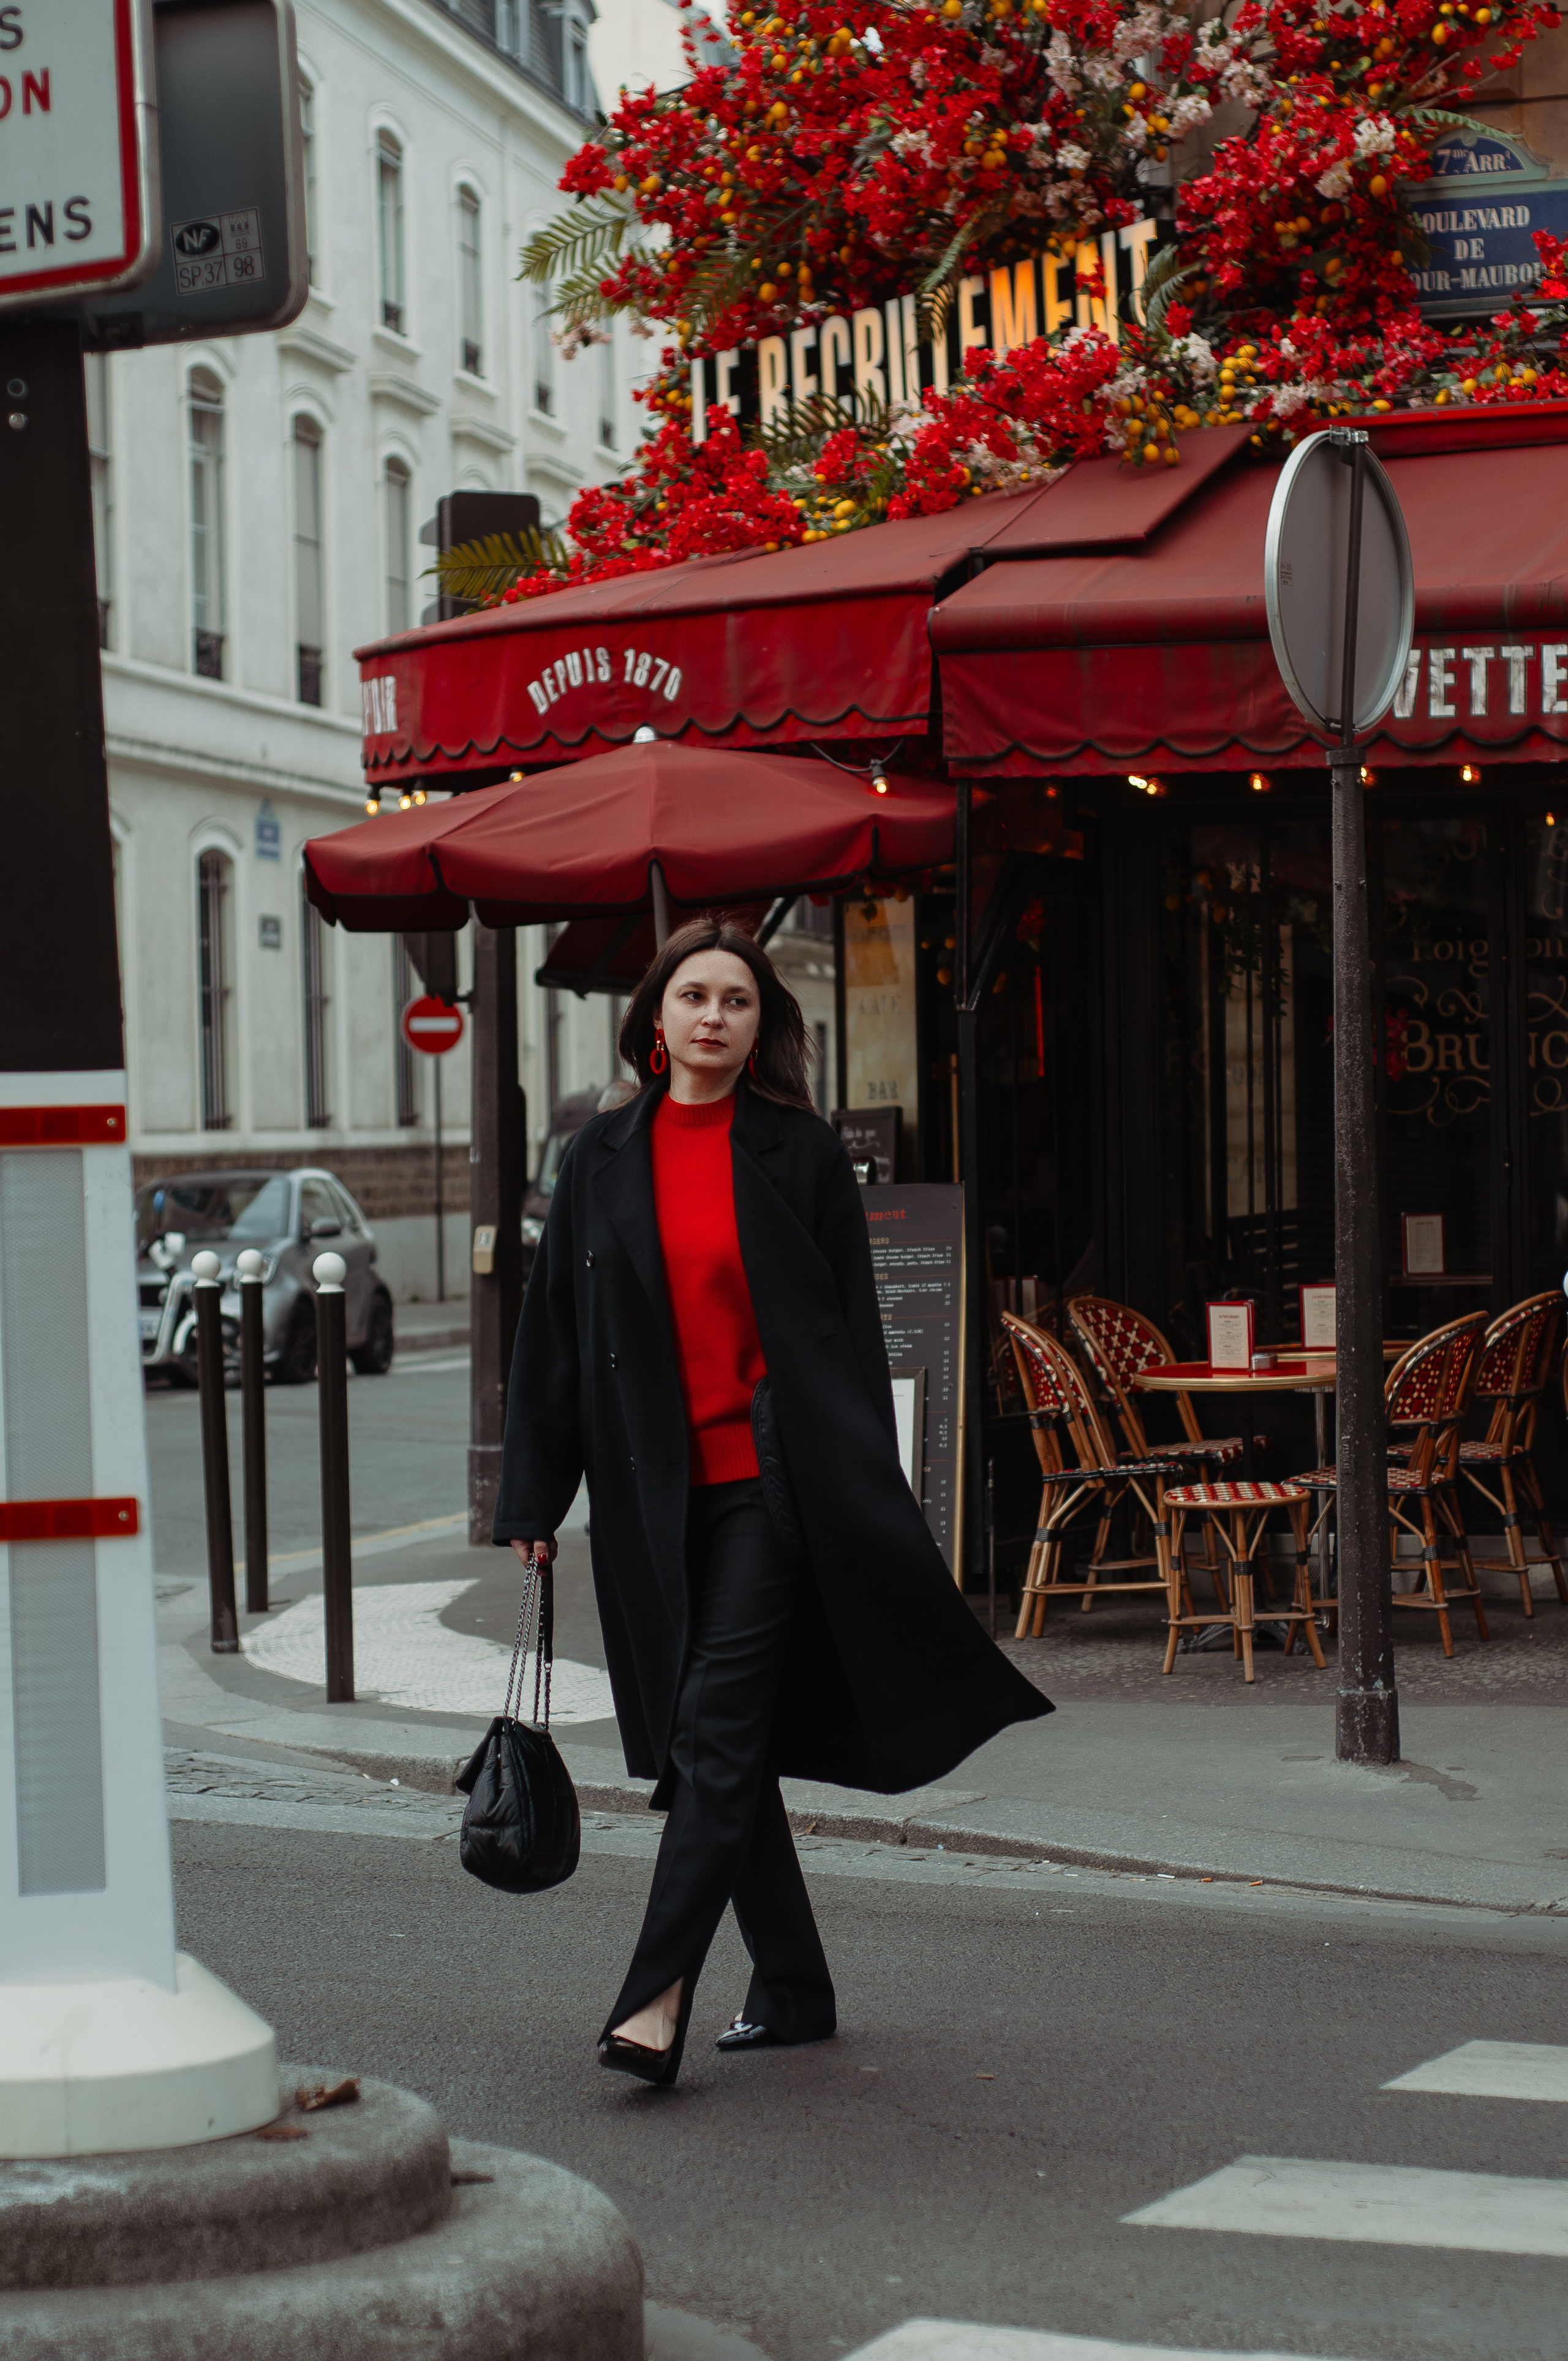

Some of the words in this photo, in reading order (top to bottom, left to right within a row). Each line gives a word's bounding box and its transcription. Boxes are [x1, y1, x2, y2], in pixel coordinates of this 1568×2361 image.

[1419, 205, 1531, 235] OULEVARD
[1454, 238, 1485, 261] DE
[233, 255, 255, 277] 98
[527, 647, 611, 715] DEPUIS
[624, 648, 684, 702] 1870
